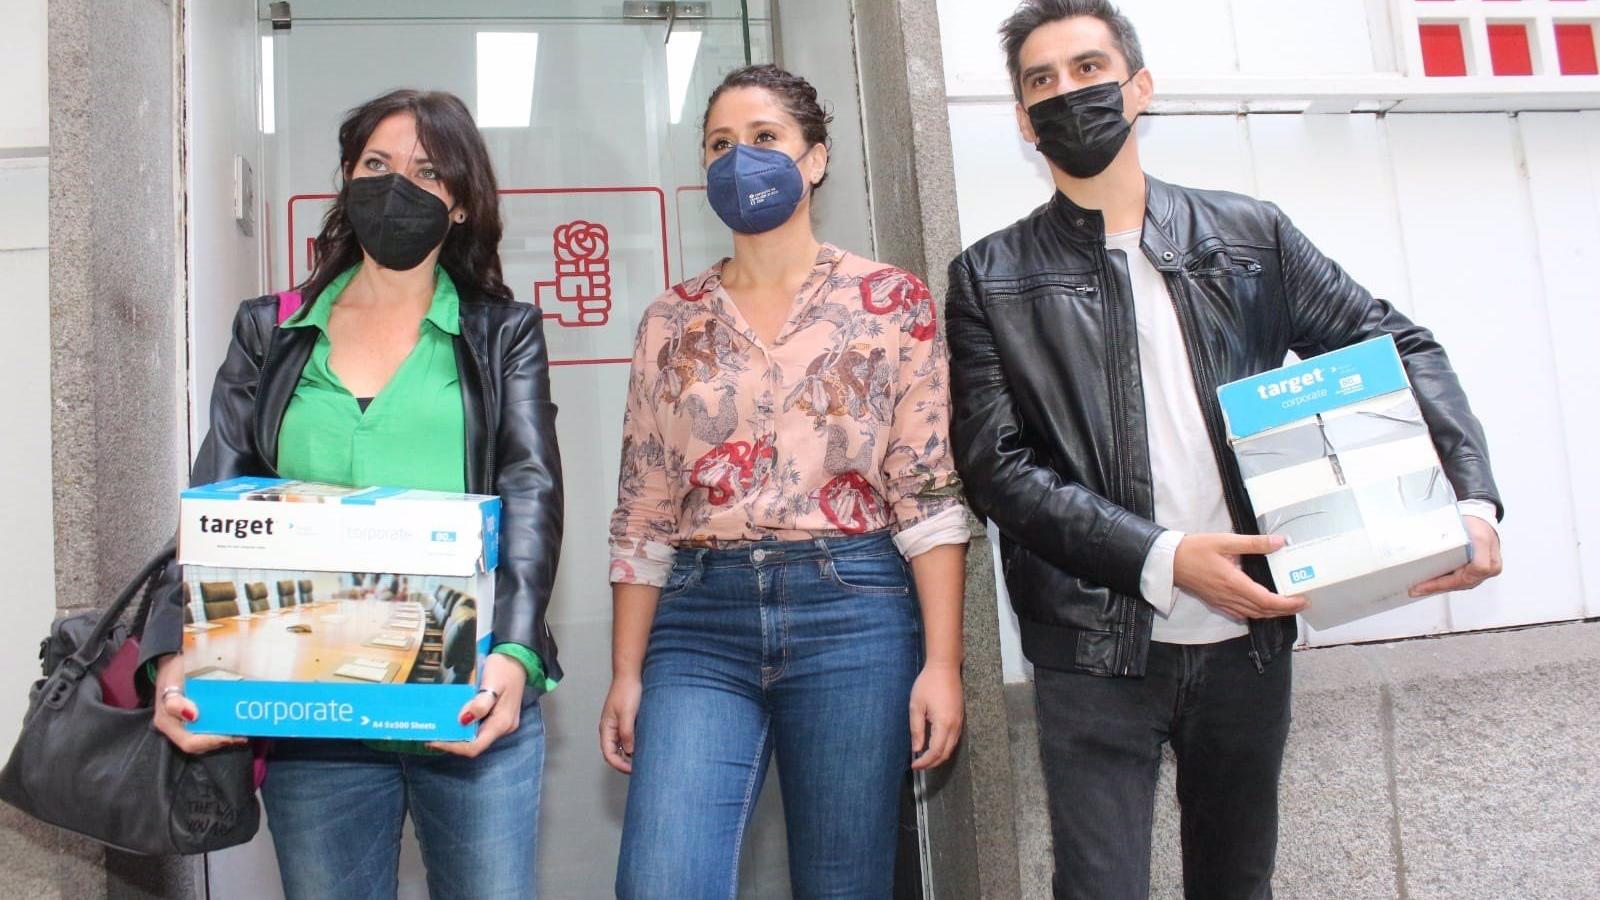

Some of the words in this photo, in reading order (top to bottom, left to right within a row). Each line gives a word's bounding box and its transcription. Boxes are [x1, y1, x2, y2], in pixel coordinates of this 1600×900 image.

[1257, 367, 1324, 399] target
[1281, 388, 1328, 409] corporate
[199, 514, 274, 539] target
[1292, 569, 1307, 582] 80
[235, 699, 353, 725] corporate
[373, 720, 383, 729] A4
[384, 721, 409, 730] 5x500
[410, 721, 436, 731] Sheets
